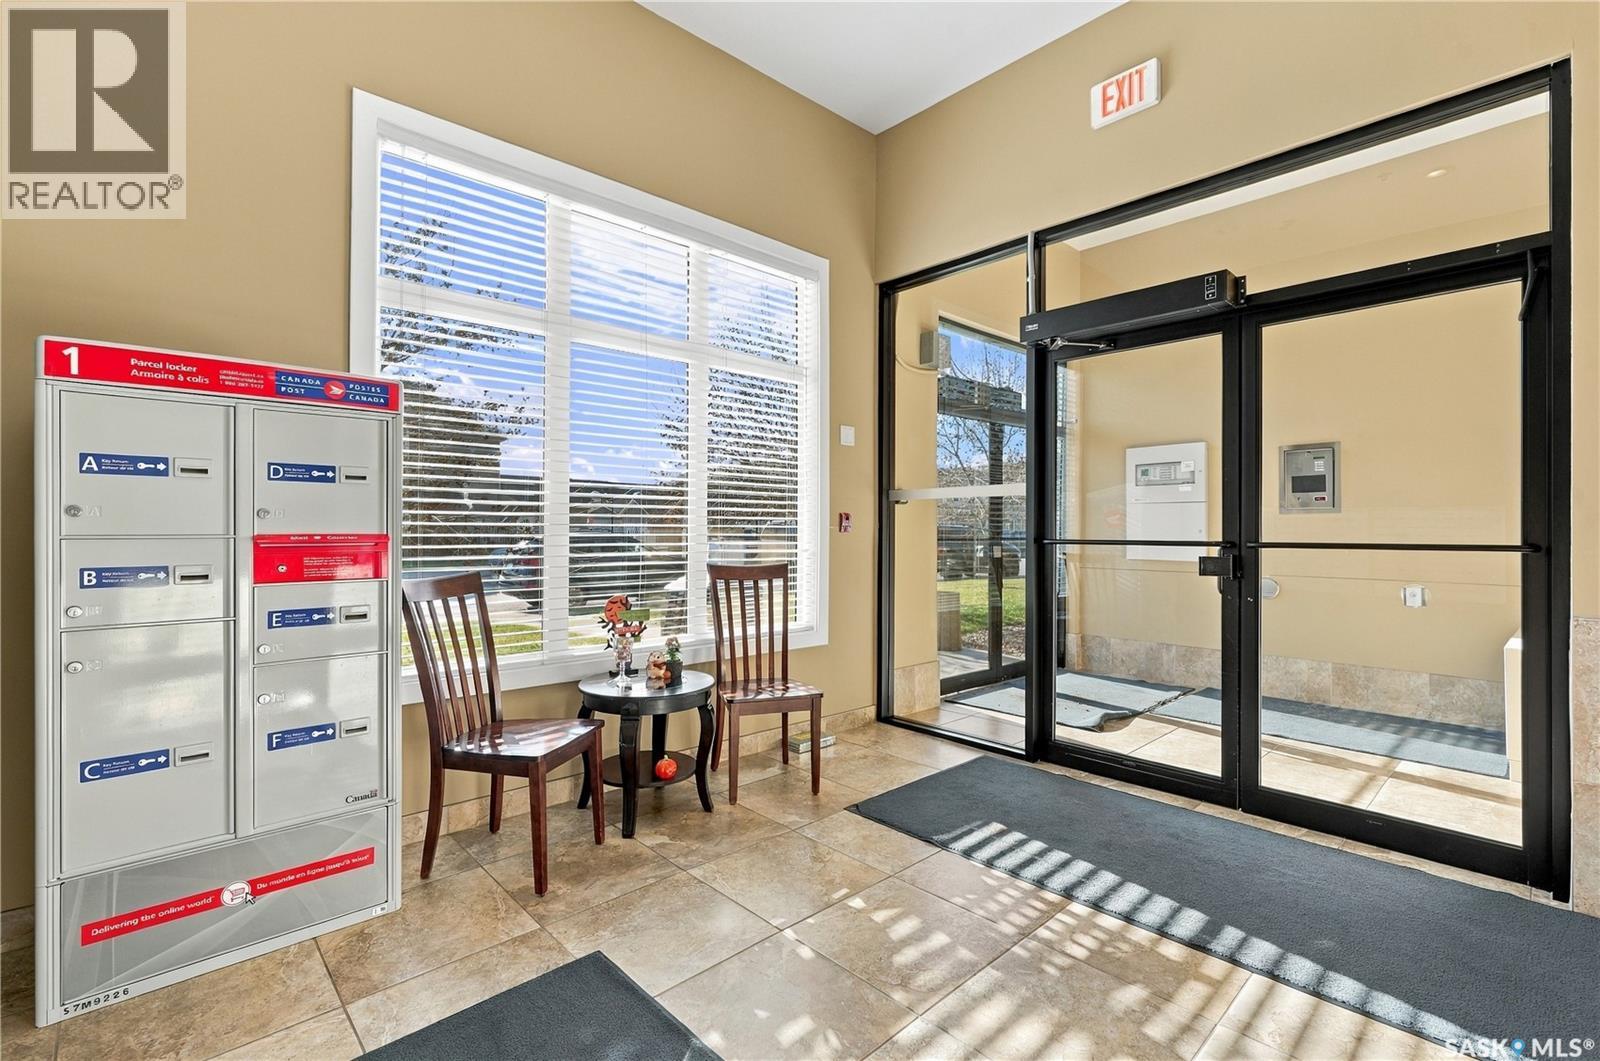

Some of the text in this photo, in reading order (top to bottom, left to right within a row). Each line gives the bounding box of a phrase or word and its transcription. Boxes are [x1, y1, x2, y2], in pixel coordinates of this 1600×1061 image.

[1102, 65, 1147, 118] EXIT
[62, 346, 79, 375] 1
[130, 358, 197, 373] Parcel locker
[130, 369, 175, 381] Armoire
[177, 373, 184, 382] à
[186, 375, 210, 385] colis
[281, 375, 321, 386] CANADA
[281, 387, 305, 395] POST
[349, 383, 381, 393] POSTES
[349, 393, 385, 403] CANADA
[81, 455, 99, 472] A
[270, 465, 284, 479] D
[83, 570, 97, 586] B
[272, 612, 282, 627] E
[272, 733, 282, 748] F
[84, 762, 101, 779] C
[256, 882, 268, 890] Du
[269, 875, 295, 886] monde
[306, 866, 325, 877] ligne
[91, 917, 139, 936] Delivering
[140, 913, 156, 923] the
[158, 904, 186, 918] online
